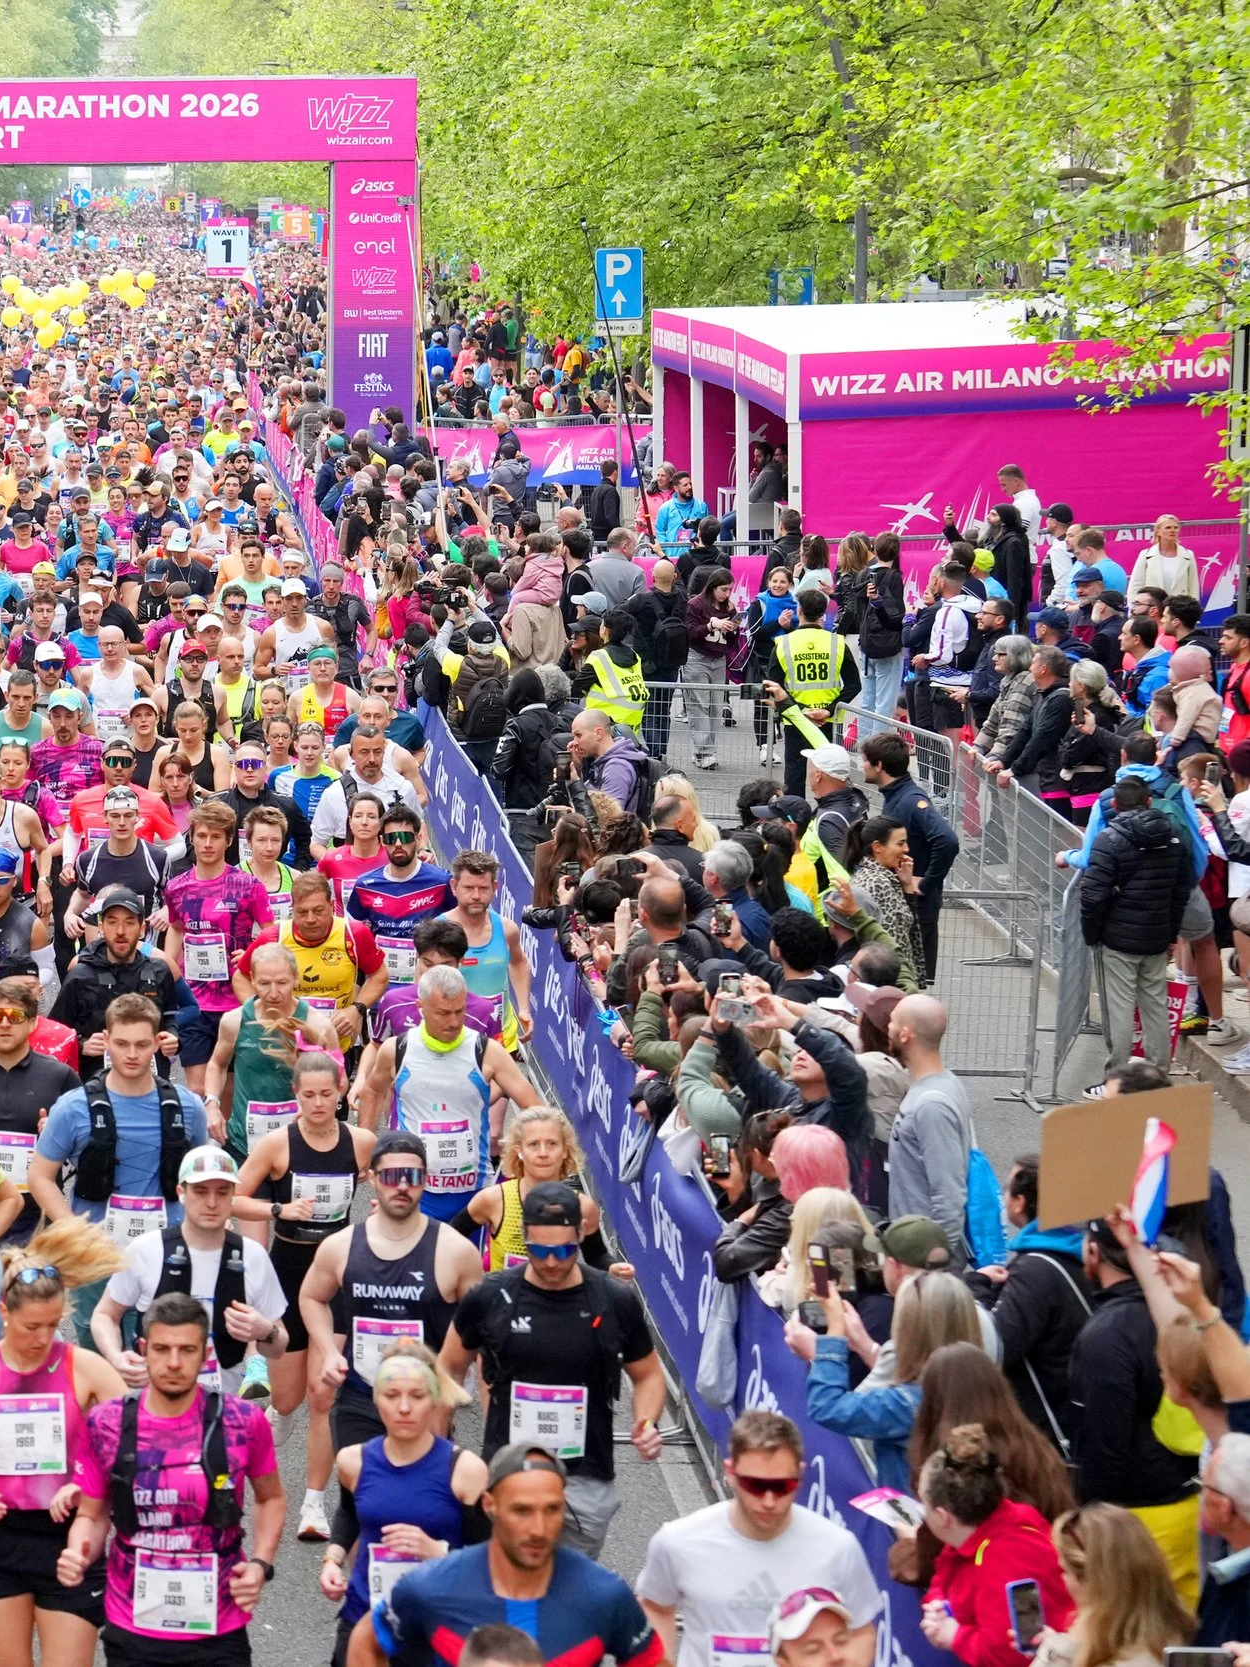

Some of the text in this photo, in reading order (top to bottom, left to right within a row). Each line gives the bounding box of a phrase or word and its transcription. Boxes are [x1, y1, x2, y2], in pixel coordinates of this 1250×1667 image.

[180, 93, 260, 118] 2026
[308, 93, 394, 135] WIZZ
[326, 136, 393, 147] wizzair.com
[365, 181, 394, 192] asics
[169, 202, 176, 211] 8
[16, 210, 26, 223] 7
[360, 213, 402, 223] UniCredit
[291, 217, 302, 234] 5
[221, 239, 232, 263] 1
[353, 237, 396, 254] enel
[606, 253, 632, 287] P
[344, 309, 359, 318] BW
[358, 333, 389, 358] FIAT
[811, 357, 1231, 397] WIZZ AIR MILANO ARATHON
[354, 384, 392, 392] FESTINA
[578, 455, 615, 463] MILANO
[794, 652, 830, 663] ASSISTENZA
[796, 662, 829, 682] 038
[409, 895, 435, 910] SMAC
[200, 920, 211, 930] AIR
[439, 1150, 457, 1158] 10223
[130, 1218, 144, 1228] PETER
[352, 1281, 424, 1301] RUNAWAY
[15, 1437, 35, 1447] 1968
[155, 1489, 178, 1505] AIR
